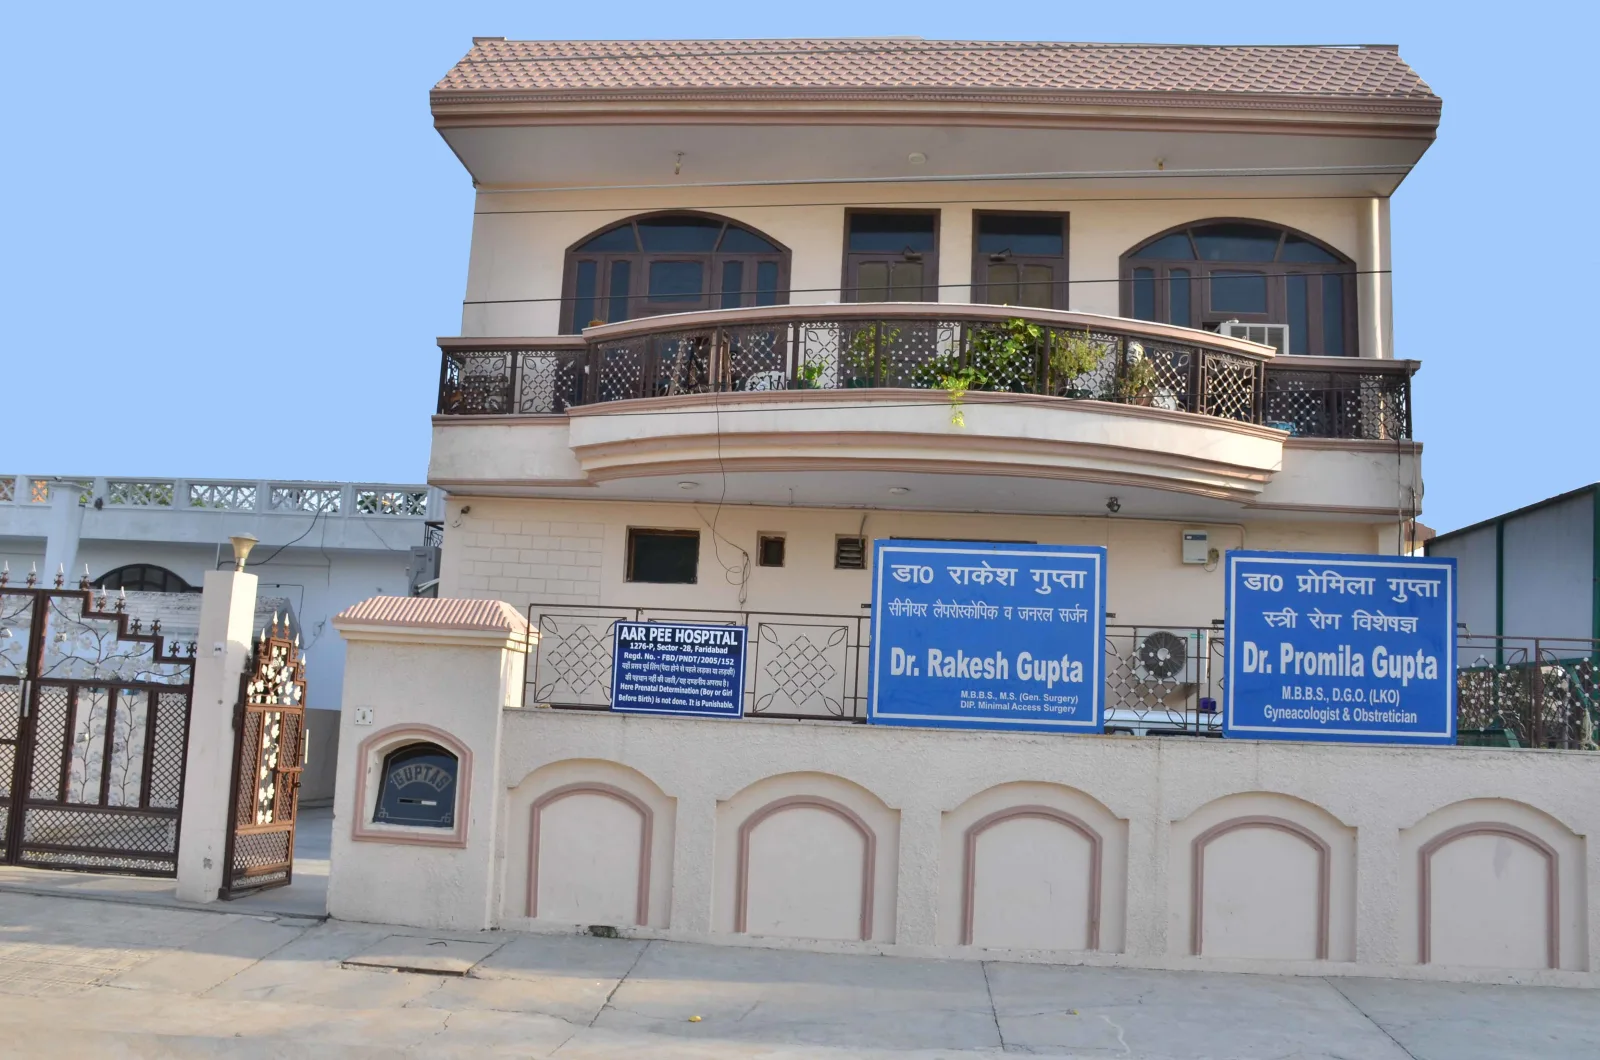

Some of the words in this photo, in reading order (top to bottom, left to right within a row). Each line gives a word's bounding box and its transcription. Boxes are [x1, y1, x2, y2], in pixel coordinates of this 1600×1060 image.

[947, 560, 1018, 586] राकेश
[1030, 569, 1087, 594] गुप्ता
[1296, 569, 1376, 595] प्रोमिला
[1387, 578, 1440, 603] गुप्ता
[888, 598, 928, 618] सीनीयर
[933, 599, 999, 620] लैपरोस्कोपिक
[1004, 606, 1013, 620] व
[1018, 607, 1053, 622] जनरल
[1058, 604, 1088, 623] सर्जन
[1262, 607, 1298, 629] स्त्री
[1307, 607, 1342, 630] रोग
[1352, 609, 1418, 634] विशेषज्ञ
[620, 626, 646, 641] AAR
[649, 628, 672, 642] PEE
[675, 629, 738, 645] HOSPITAL
[630, 642, 655, 651] 1276-P,
[695, 646, 728, 654] Faridabad
[624, 652, 642, 660] Regd.
[662, 654, 734, 665] FBD/PNDT/2005/152
[890, 647, 920, 677] Dr.
[928, 648, 1008, 680] Rakesh
[1017, 651, 1083, 689] Gupta
[1243, 641, 1272, 674] Dr.
[1280, 642, 1364, 678] Promila
[1372, 646, 1437, 686] Gupta
[659, 685, 699, 694] Determination
[700, 688, 714, 697] (Boy
[960, 690, 998, 700] M.B.B.S.,
[1000, 692, 1017, 700] M.S.
[1019, 692, 1041, 702] (Gen.
[1044, 693, 1079, 704] Surgery)
[1282, 686, 1329, 703] M.B.B.S.,
[1332, 688, 1367, 702] D.G.O.
[1370, 689, 1400, 706] (LKO)
[638, 695, 654, 704] Birth)
[702, 700, 734, 708] Punishable.
[960, 700, 976, 708] DIP.
[978, 701, 1010, 710] Minimal
[1012, 702, 1041, 712] Access
[1044, 704, 1076, 714] Surgery
[1264, 705, 1339, 724] Gyneacologist
[1342, 708, 1350, 721] &
[1354, 708, 1417, 723] Obstretician
[392, 764, 451, 790] GUPTAS
